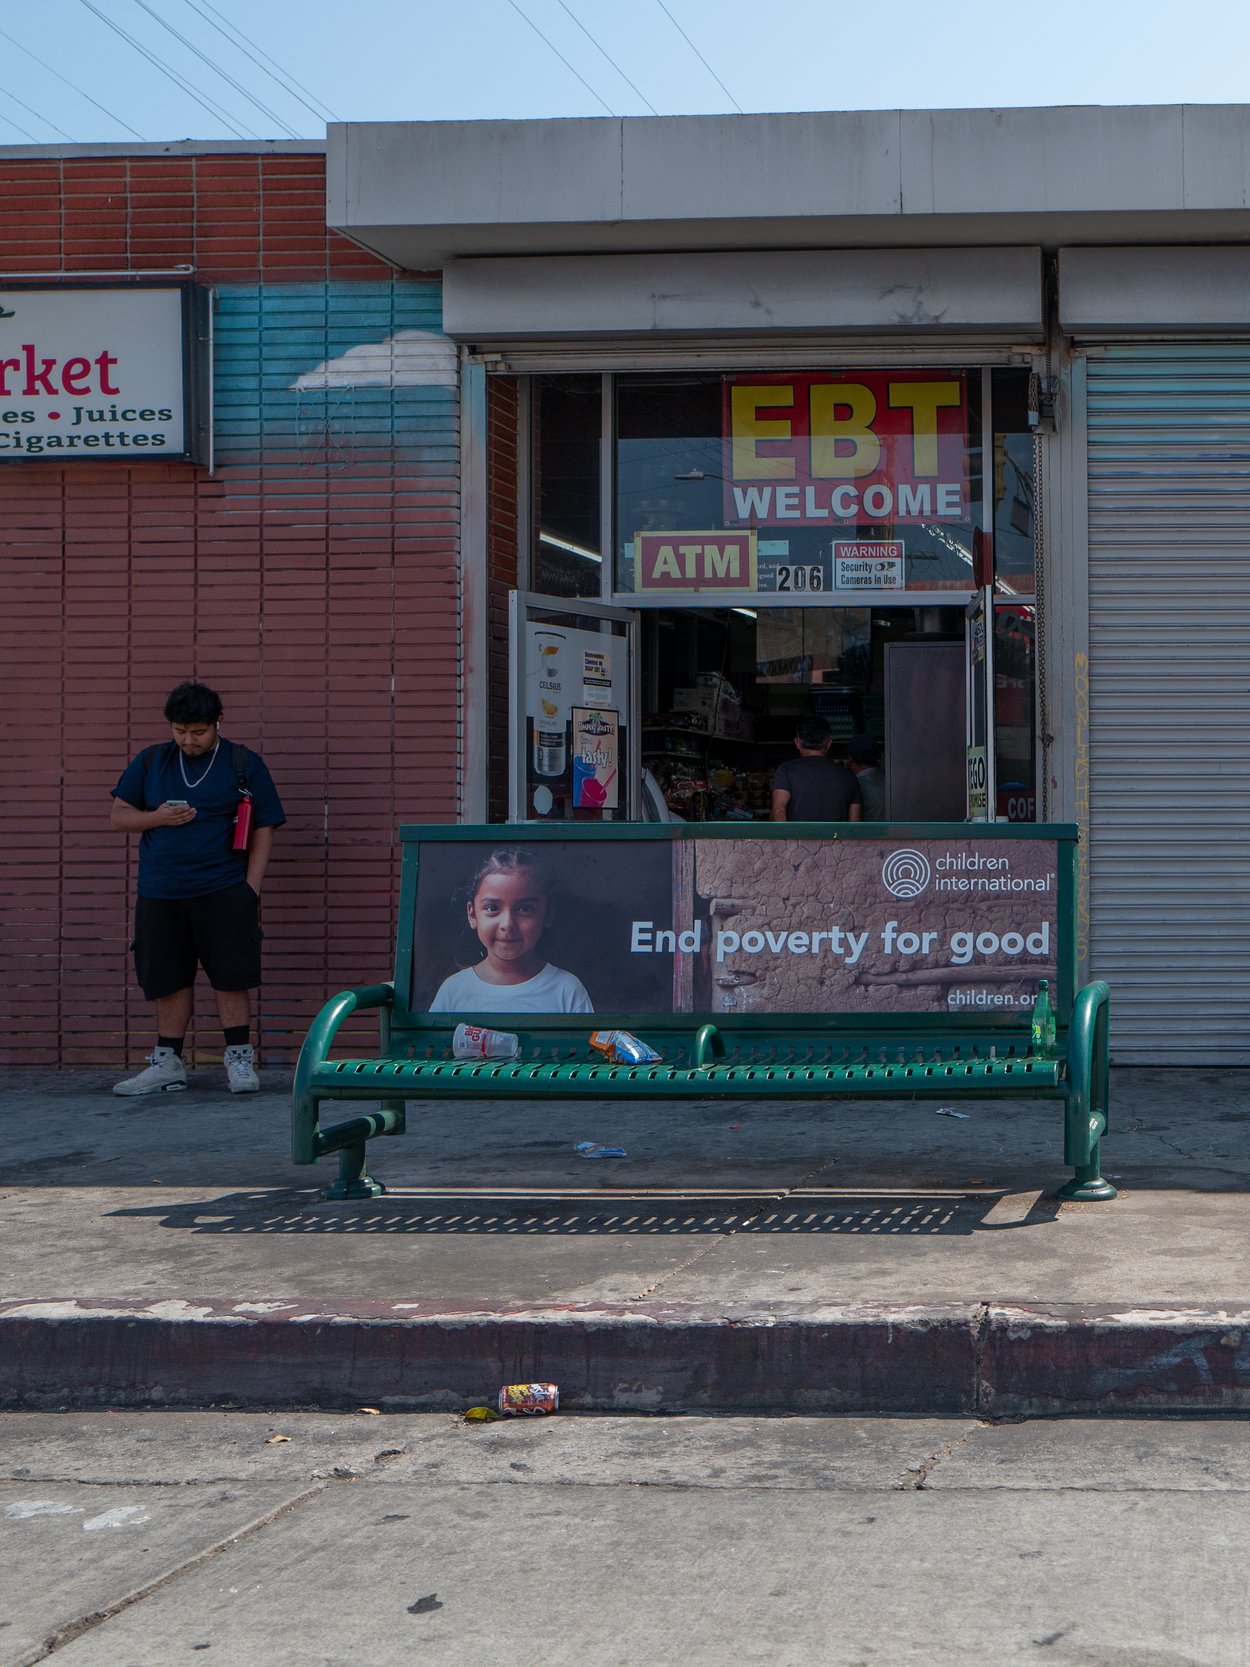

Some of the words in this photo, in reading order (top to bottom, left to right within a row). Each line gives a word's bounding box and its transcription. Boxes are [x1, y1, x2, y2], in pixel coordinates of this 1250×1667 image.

[0, 344, 121, 396] rket
[2, 410, 36, 424] es
[72, 405, 174, 426] Juices
[730, 381, 961, 481] EBT
[0, 431, 167, 454] Cigarettes
[733, 484, 962, 519] WELCOME
[651, 545, 741, 579] ATM
[839, 546, 898, 557] WARNING
[840, 561, 873, 573] Security
[777, 566, 824, 592] 206
[840, 575, 873, 585] Cameras
[874, 575, 882, 585] In
[883, 575, 897, 585] Use
[539, 680, 562, 692] CELSIUS
[581, 747, 612, 769] tasty!
[1008, 797, 1035, 819] COF
[935, 852, 1009, 873] children
[631, 921, 701, 953] End
[717, 924, 868, 964] poverty
[881, 921, 937, 953] for
[949, 921, 1049, 963] good
[947, 989, 1039, 1005] children.or
